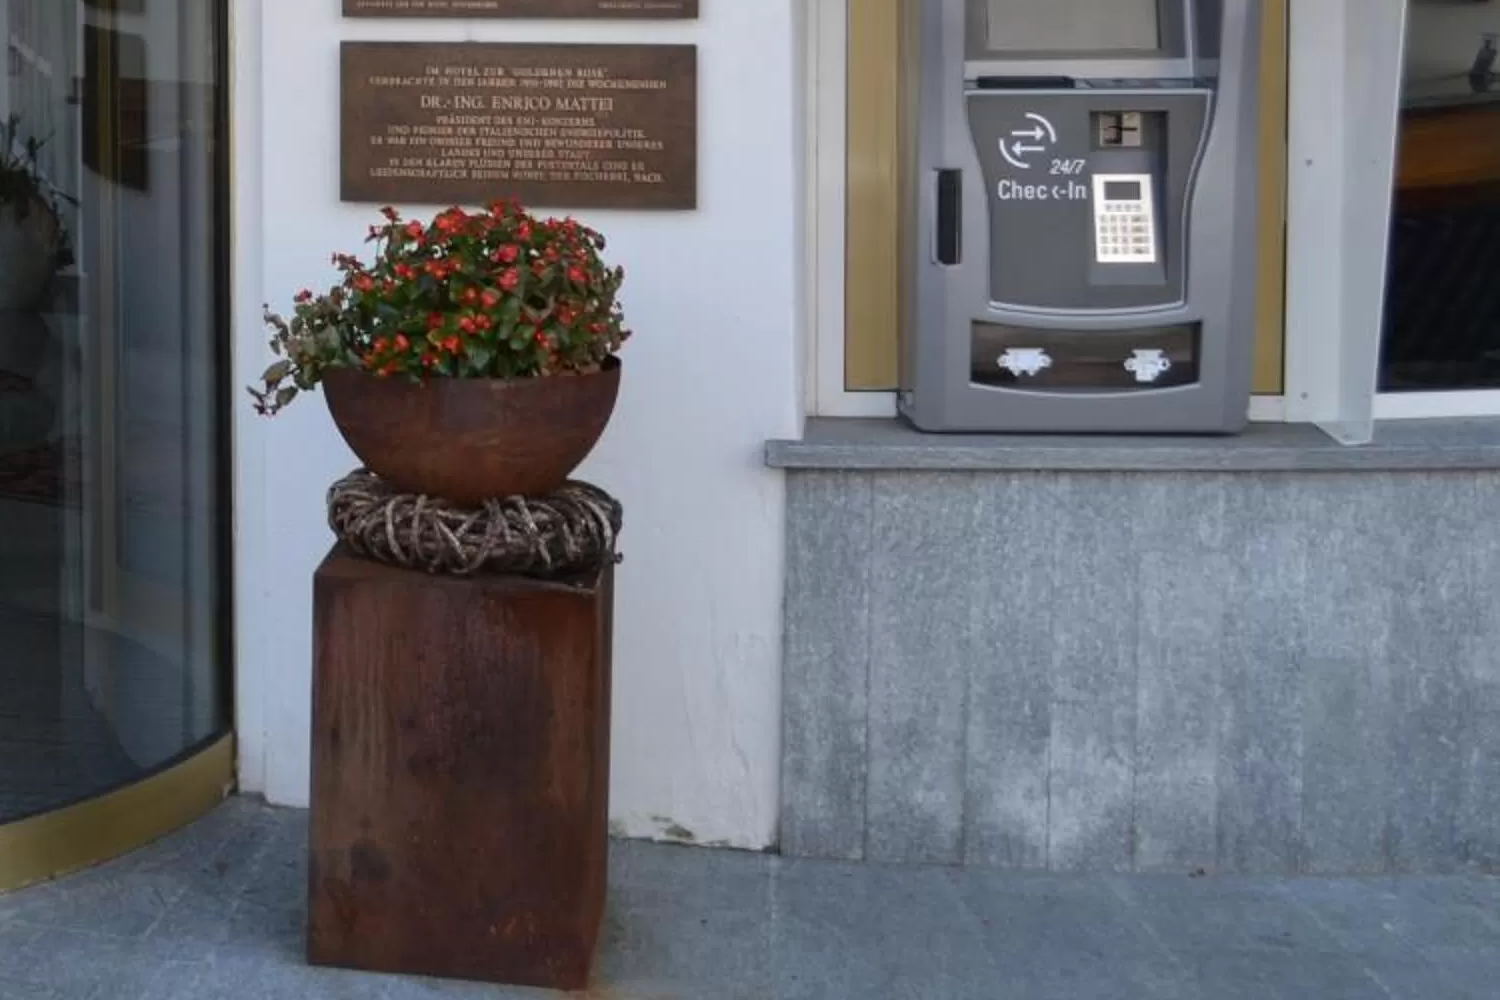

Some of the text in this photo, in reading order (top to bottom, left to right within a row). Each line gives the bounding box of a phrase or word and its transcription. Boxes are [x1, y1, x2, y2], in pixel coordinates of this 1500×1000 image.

[491, 95, 551, 111] ENRICO
[555, 97, 613, 111] MATTEI
[1049, 159, 1086, 175] 24/7
